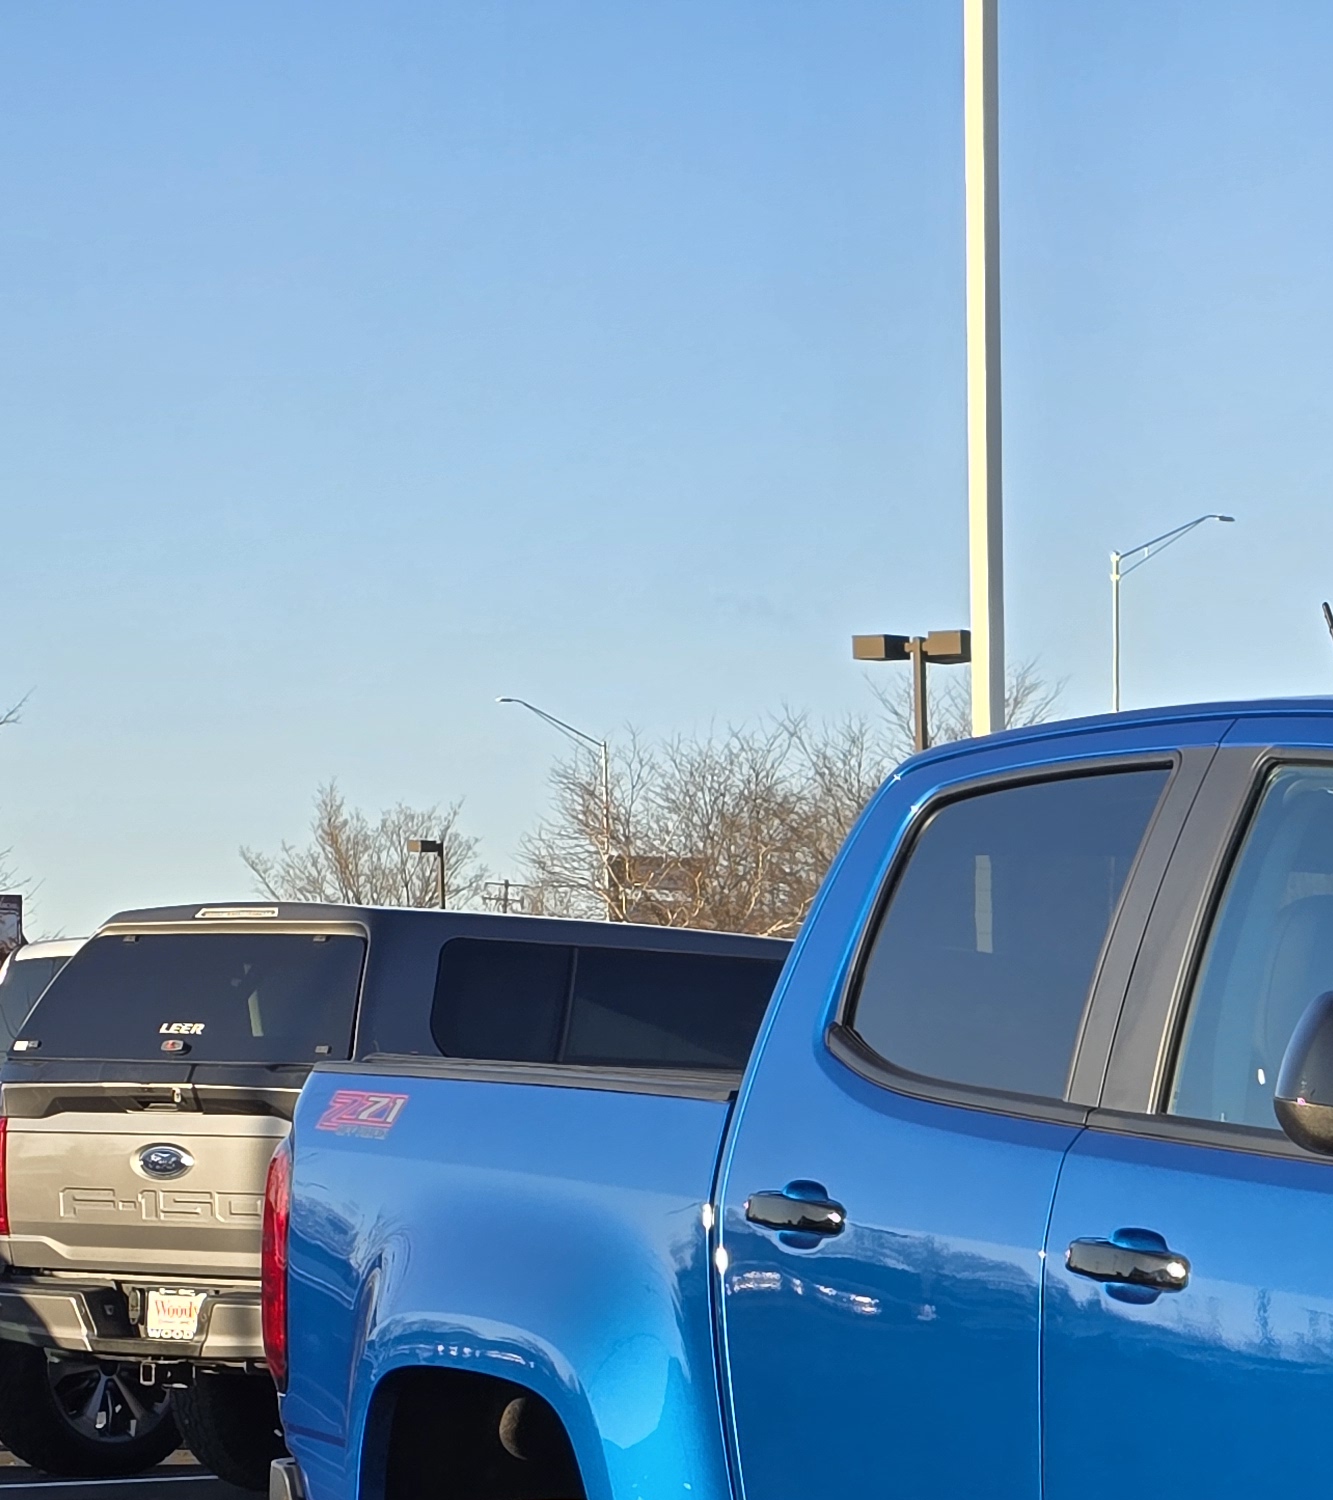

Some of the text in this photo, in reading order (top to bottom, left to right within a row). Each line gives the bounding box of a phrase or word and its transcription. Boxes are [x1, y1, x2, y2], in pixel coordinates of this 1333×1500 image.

[159, 1023, 205, 1035] LEER
[315, 1090, 409, 1131] Z71
[59, 1186, 265, 1223] F-150
[155, 1300, 200, 1318] Woody
